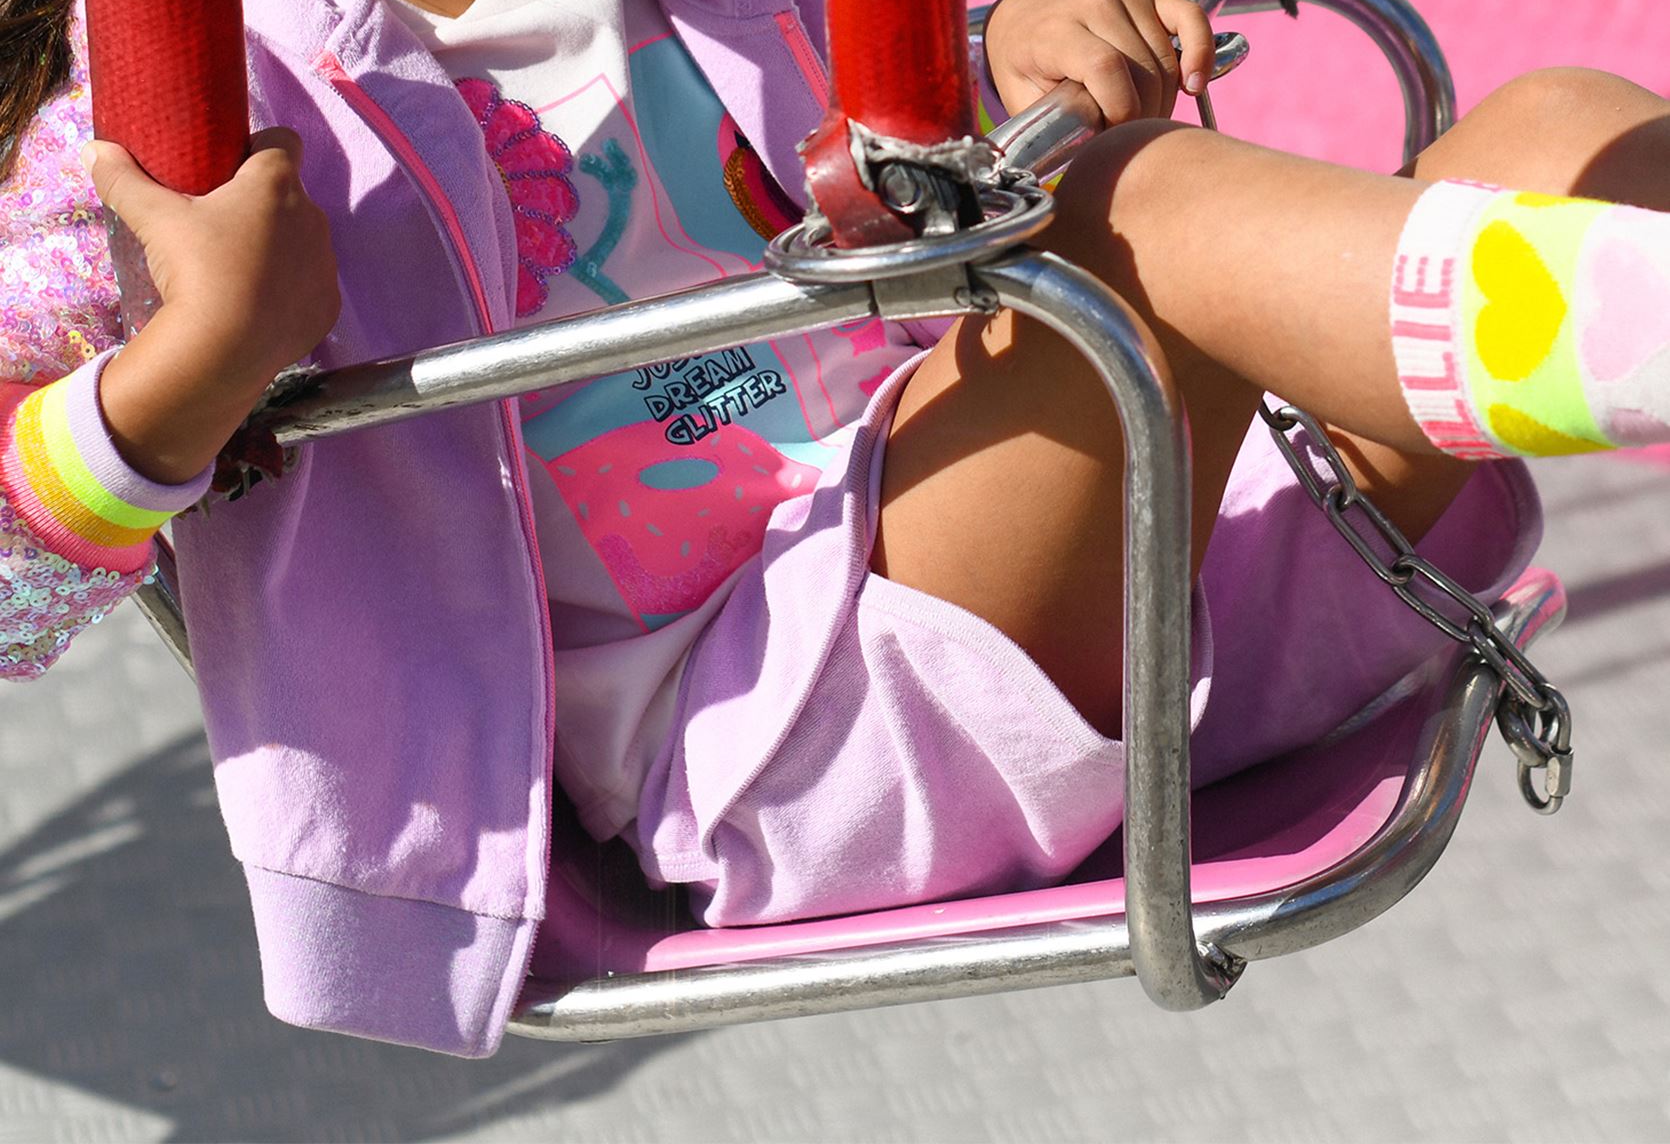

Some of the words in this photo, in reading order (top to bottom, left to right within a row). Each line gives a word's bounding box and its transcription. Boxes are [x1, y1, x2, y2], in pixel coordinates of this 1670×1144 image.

[644, 346, 756, 422] DREAM
[1392, 254, 1505, 460] ILLIE
[665, 370, 787, 445] GLITTER
